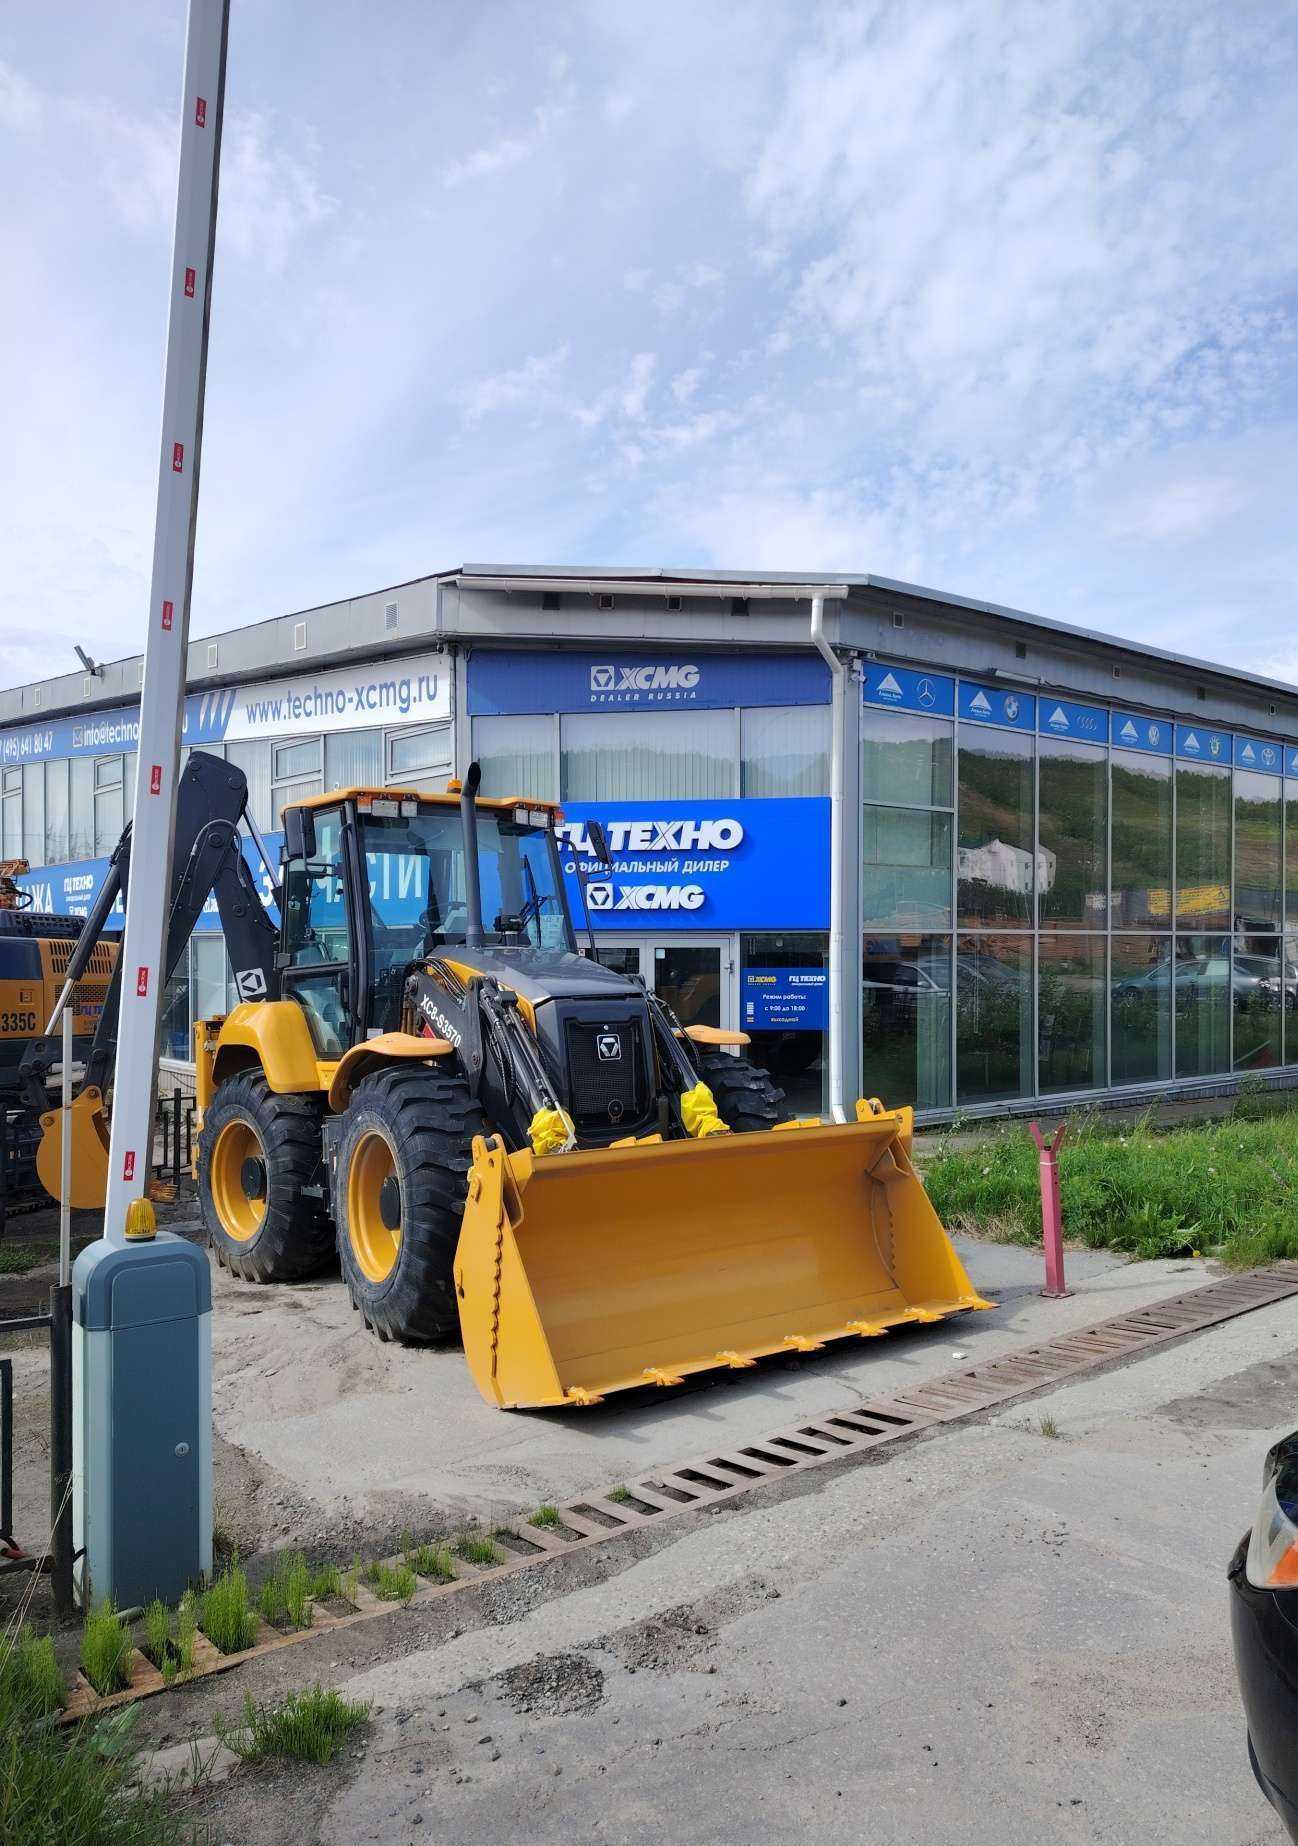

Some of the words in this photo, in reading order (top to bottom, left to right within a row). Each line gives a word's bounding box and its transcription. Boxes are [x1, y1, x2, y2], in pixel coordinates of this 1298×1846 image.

[614, 664, 700, 690] XCMG
[246, 674, 438, 725] www.techno-xcmg.ru
[590, 693, 640, 702] DEALER
[648, 691, 697, 700] RUSSIA
[607, 818, 744, 851] ТЕХНО
[682, 859, 730, 875] ДИЛЕР
[613, 885, 705, 910] XCMG
[420, 993, 462, 1048] XC8-S3570
